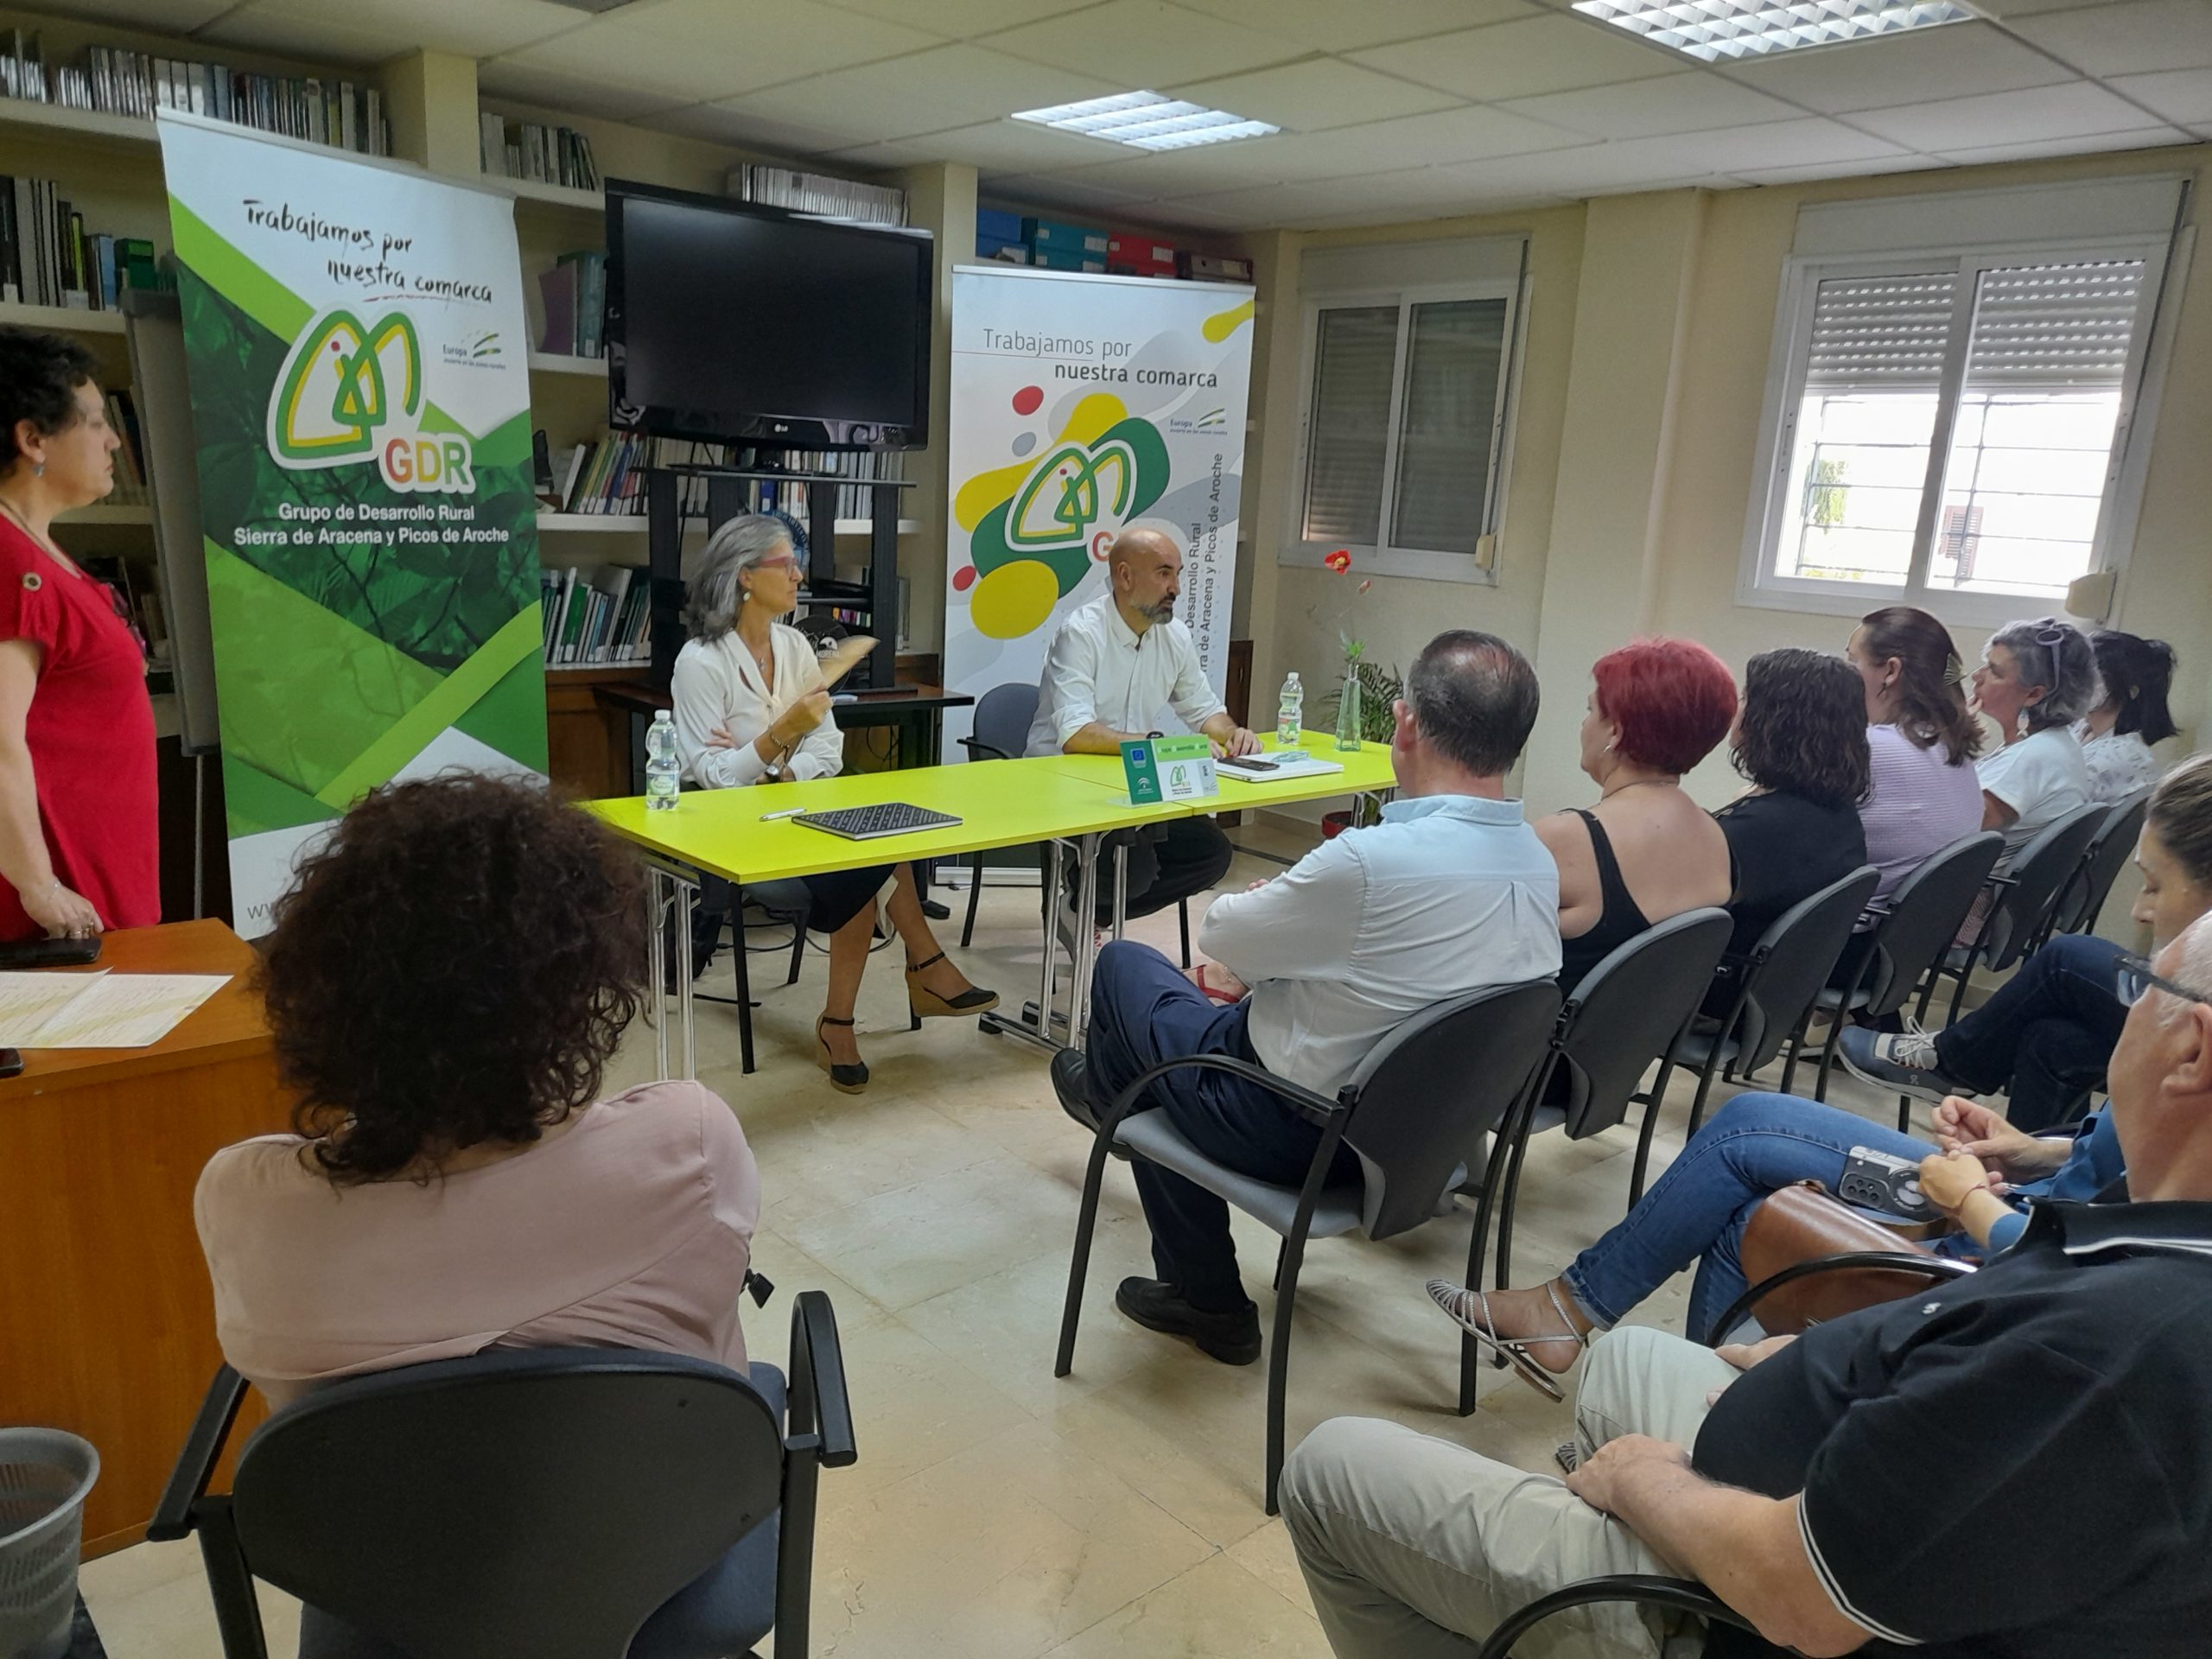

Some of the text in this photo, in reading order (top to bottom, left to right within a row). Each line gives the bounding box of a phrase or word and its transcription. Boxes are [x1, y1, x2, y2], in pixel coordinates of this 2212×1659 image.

[243, 200, 412, 260] Trabajamos por
[327, 259, 492, 303] nuestra comarca
[983, 328, 1132, 359] Trabajamos por
[1055, 364, 1217, 387] nuestra comarca
[385, 438, 469, 485] GDR
[1210, 453, 1223, 507] Aroche
[278, 503, 474, 523] Grupo de Desarrollo Rural
[1207, 507, 1218, 524] de
[234, 526, 509, 546] Sierra de Aracena y Picos de Aroche
[1205, 525, 1217, 562] Picos
[1185, 523, 1201, 629] Desarrollo Rural
[1200, 578, 1214, 632] Aracena
[1196, 635, 1209, 651] de
